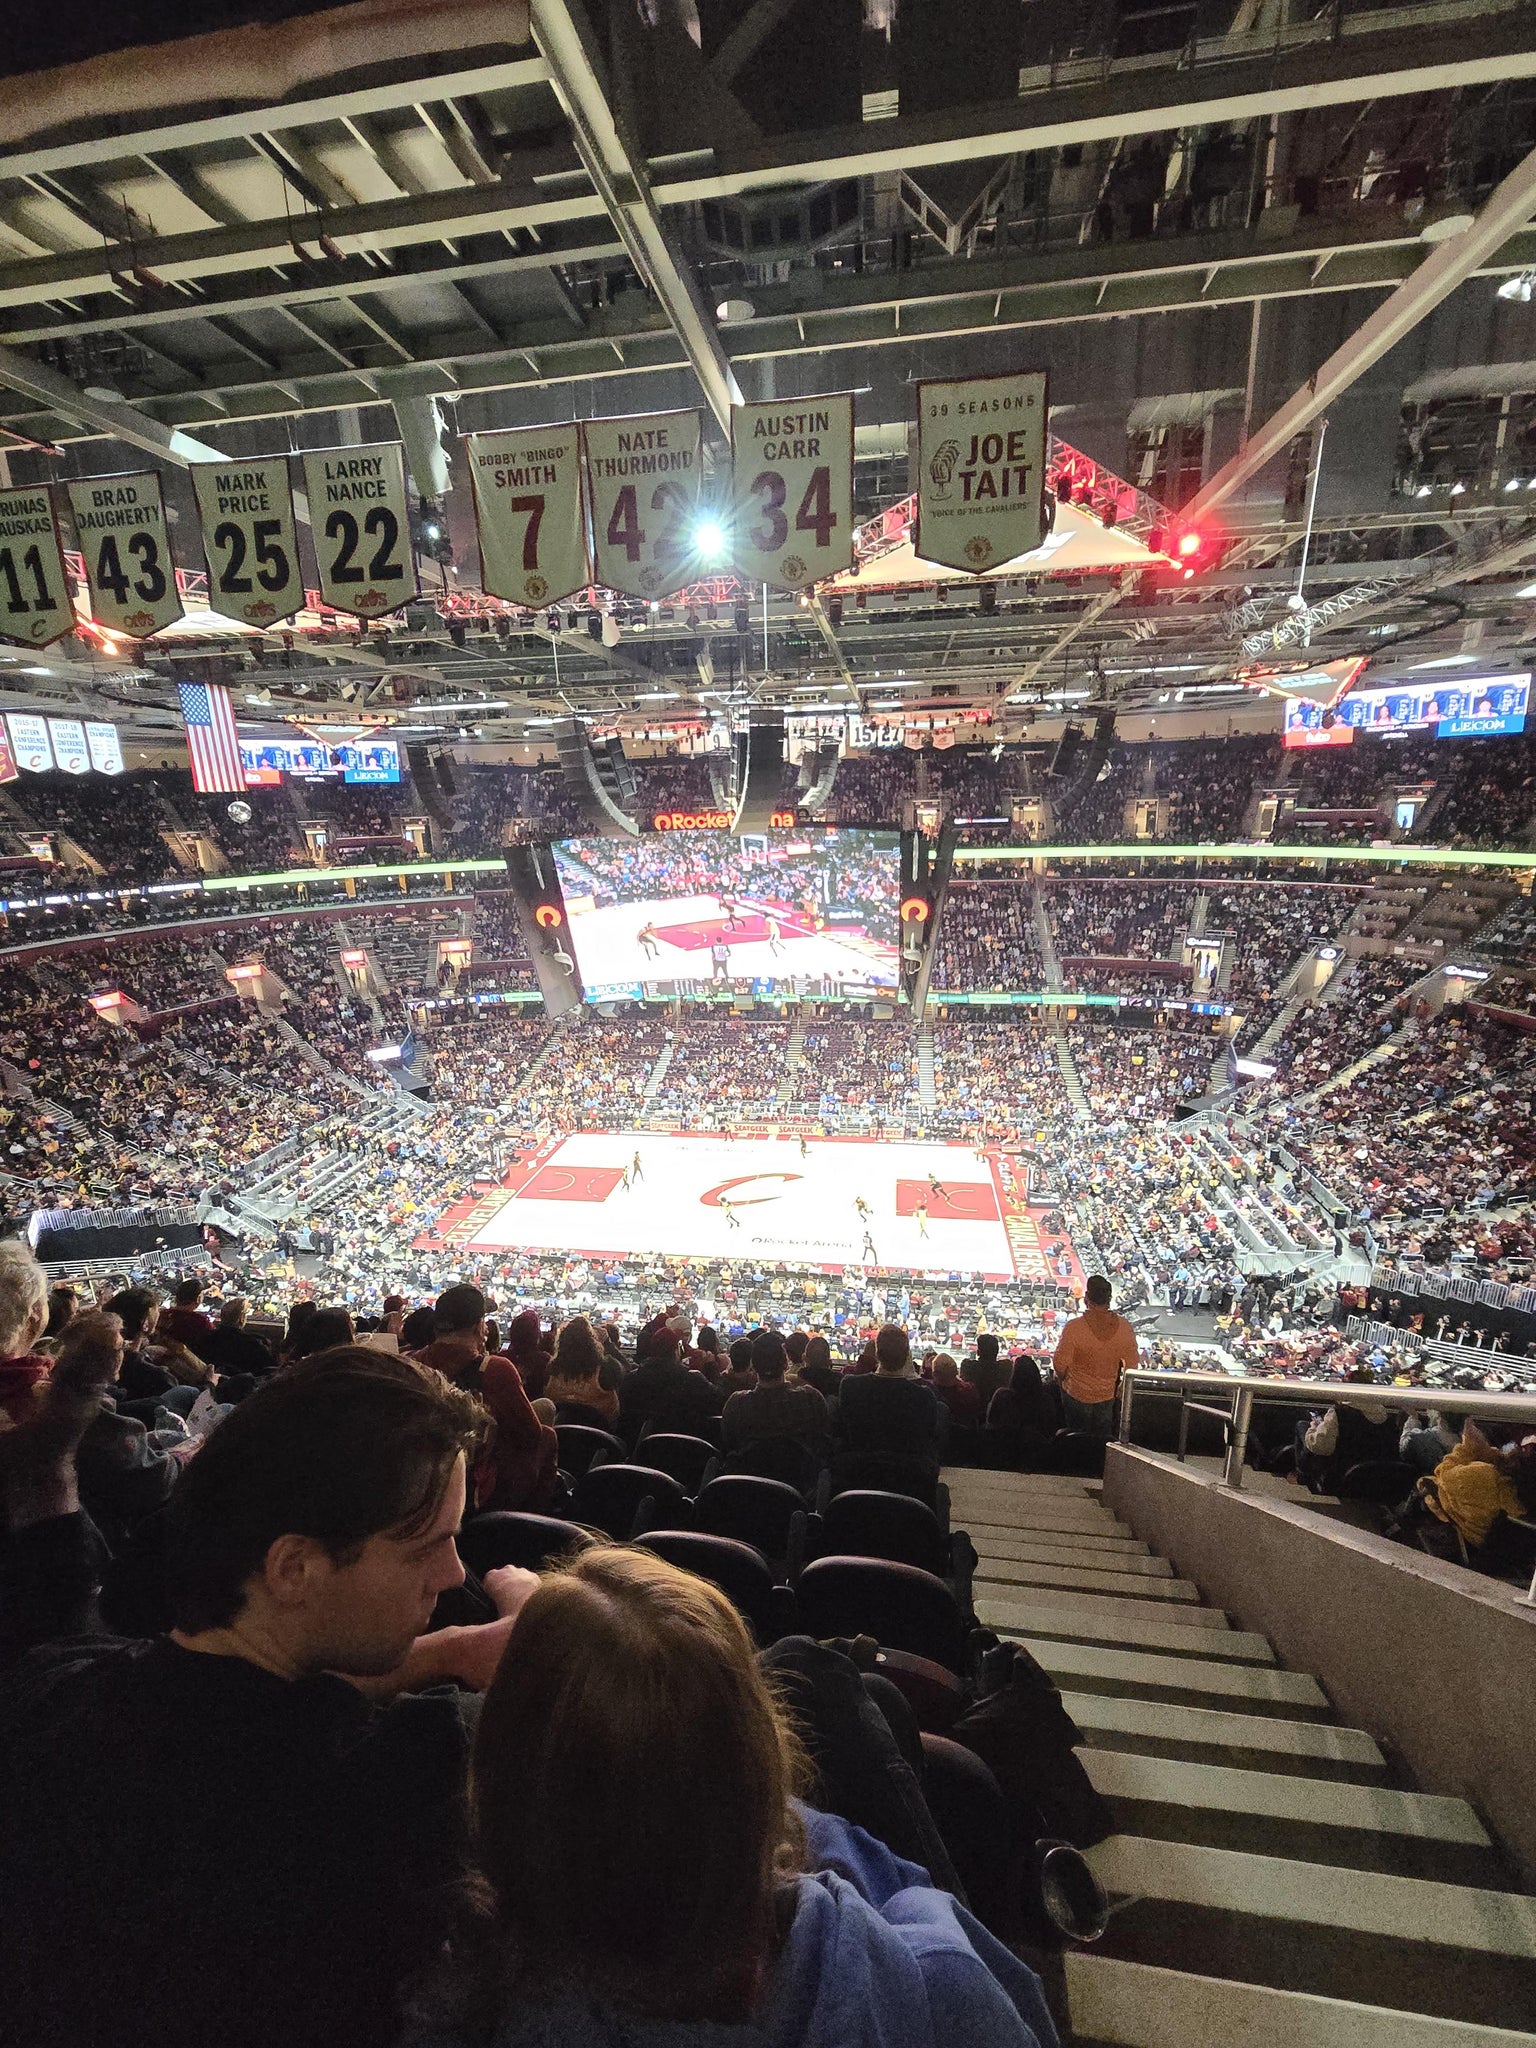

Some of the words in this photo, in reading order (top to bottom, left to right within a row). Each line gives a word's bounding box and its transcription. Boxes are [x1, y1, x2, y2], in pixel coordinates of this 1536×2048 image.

[930, 404, 949, 418] 39
[958, 394, 1035, 415] SEASONS
[754, 411, 830, 438] AUSTIN
[617, 429, 669, 452] NATE
[763, 438, 821, 461] CARR
[965, 429, 1027, 467] JOE
[324, 456, 383, 480] LARRY
[478, 452, 517, 468] BOBBY
[520, 446, 570, 463] "BINGO"
[594, 451, 694, 478] THURMOND
[214, 471, 268, 493] MARK
[494, 464, 557, 488] SMITH
[958, 464, 1033, 502] TAIT
[91, 486, 137, 508] BRAD
[326, 479, 387, 502] NANCE
[217, 493, 270, 514] PRICE
[750, 465, 837, 553] 34
[76, 504, 161, 530] DAUGHERTY
[606, 480, 697, 563] 42
[511, 494, 546, 571] 7
[214, 518, 290, 593] 25
[324, 506, 404, 584] 22
[0, 544, 58, 613] 11
[97, 531, 167, 605] 43
[854, 727, 872, 743] 15
[881, 727, 900, 742] 27
[671, 810, 736, 830] Rocket
[651, 1122, 680, 1130] SEATGEEK
[734, 1124, 769, 1133] SEATGEEK
[778, 1125, 814, 1134] SEATGEEK
[443, 1188, 518, 1243] CLEVELAND
[1004, 1214, 1049, 1277] CAVALIERS
